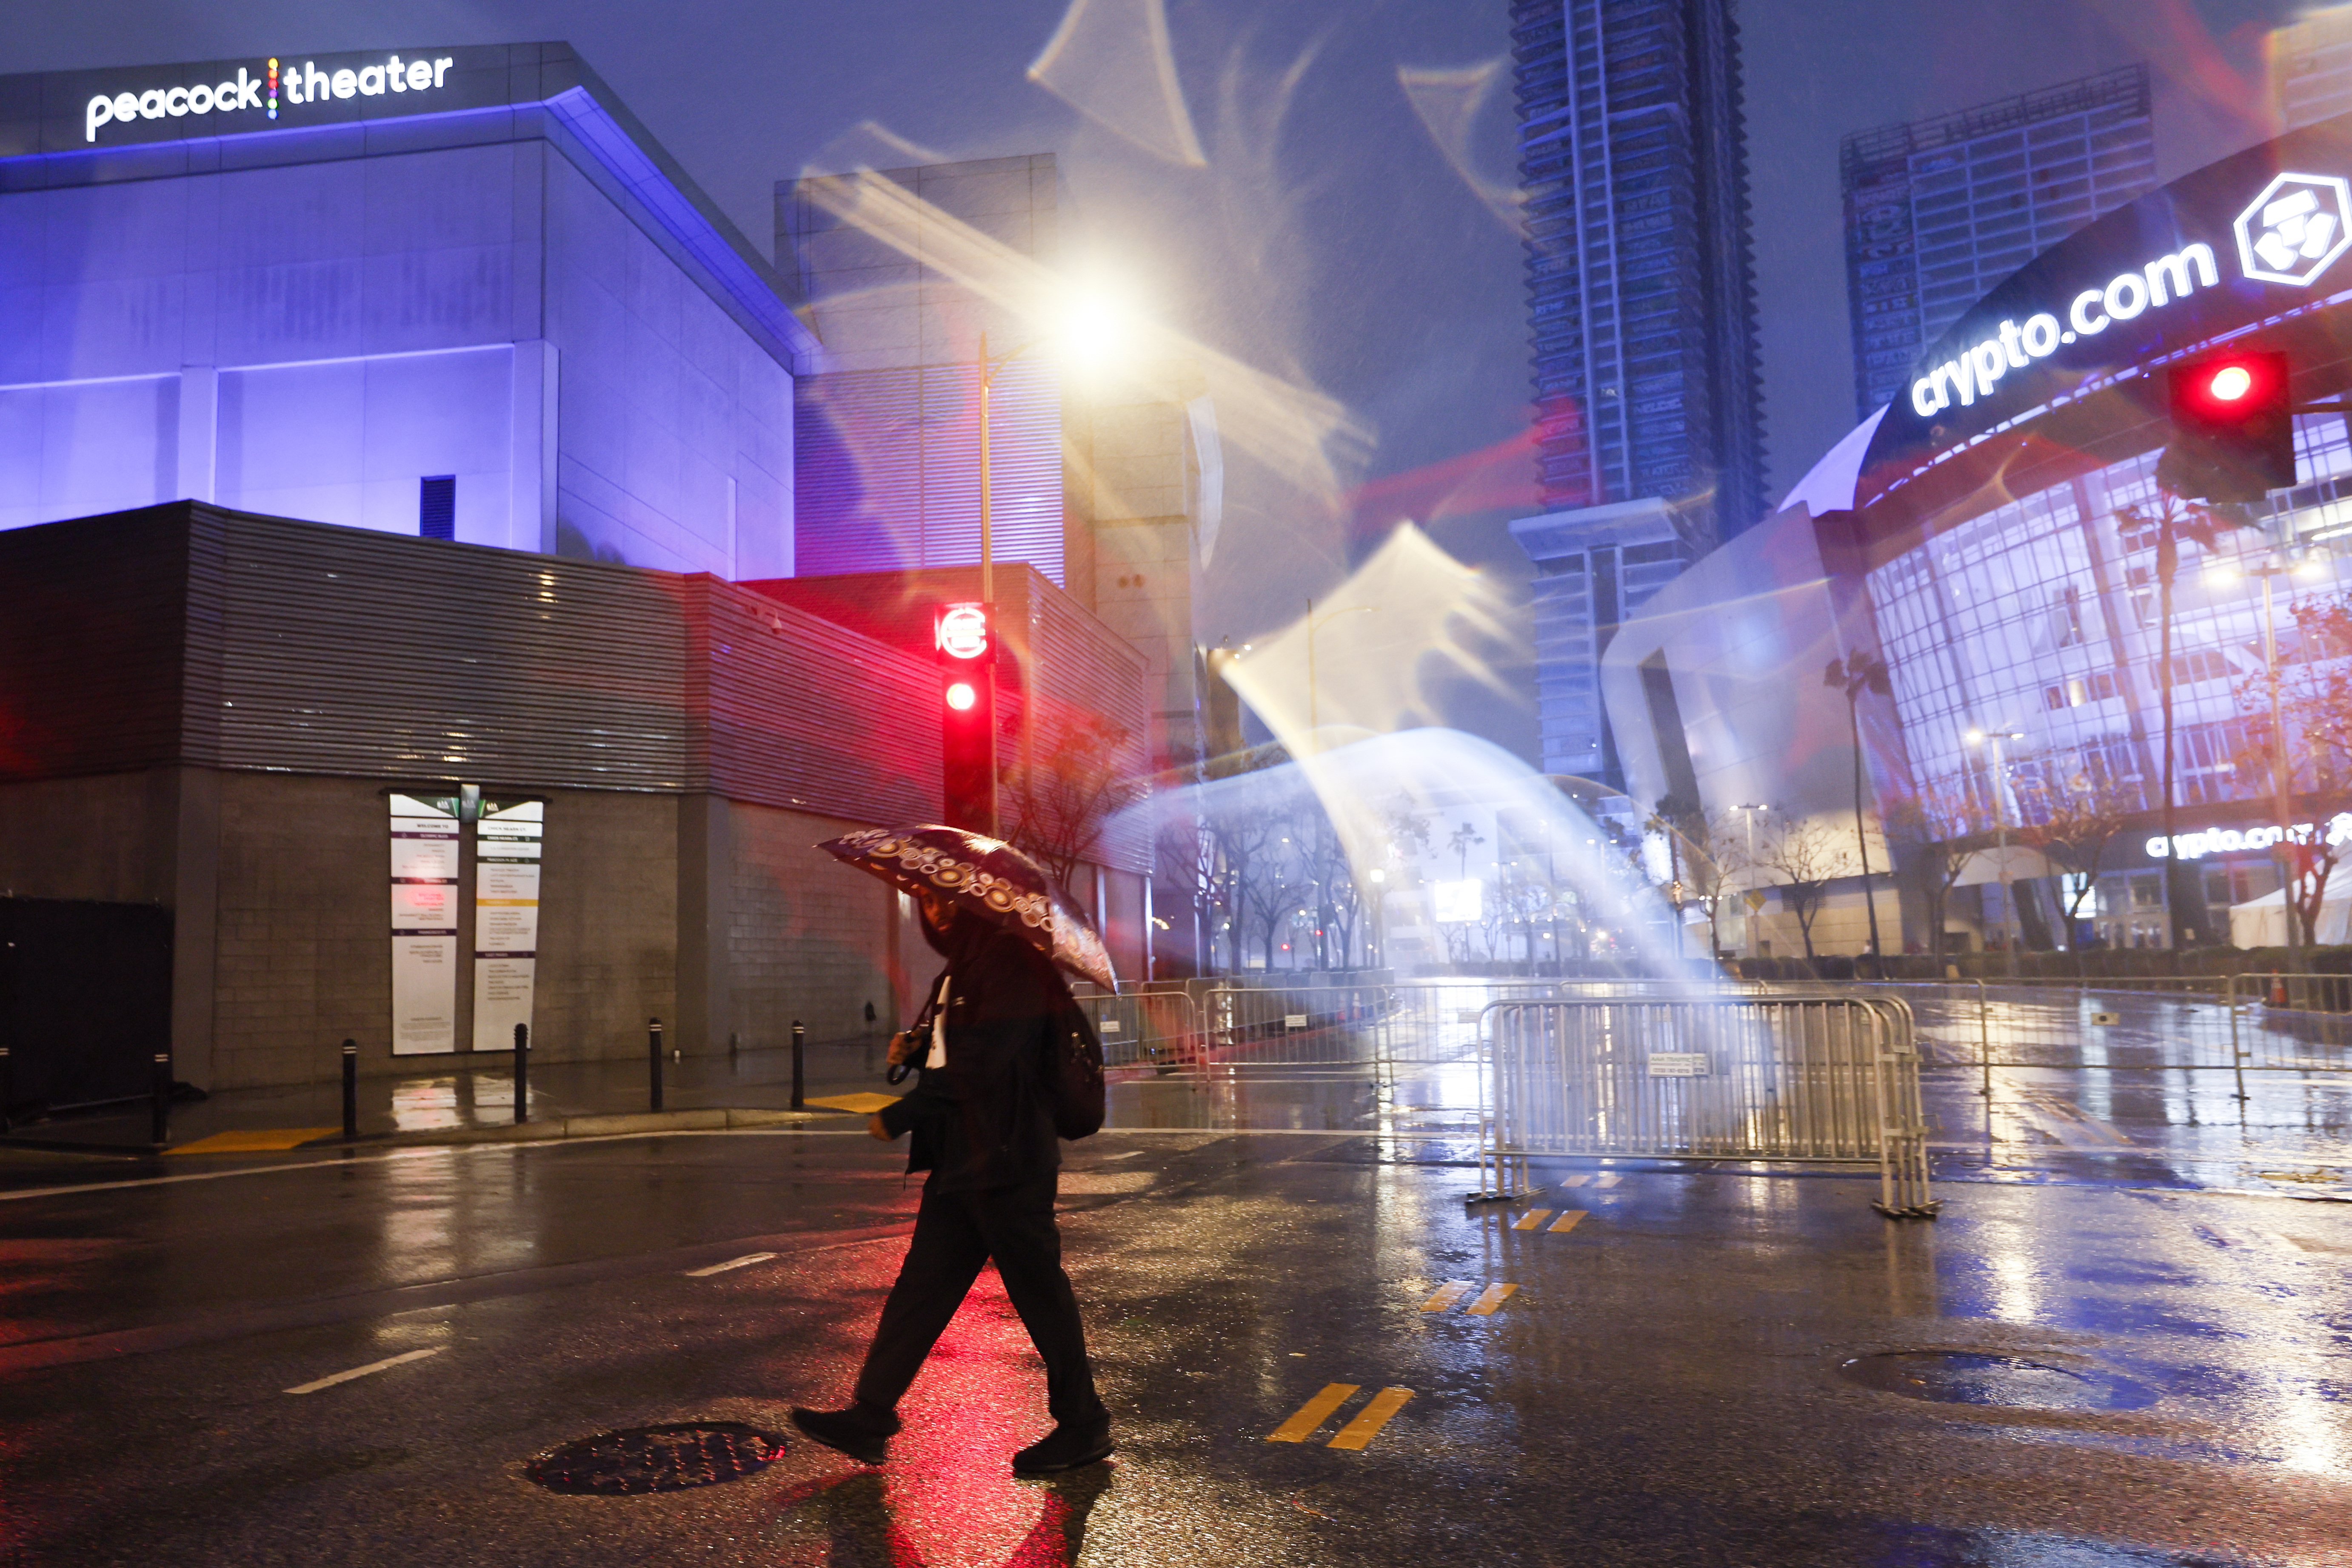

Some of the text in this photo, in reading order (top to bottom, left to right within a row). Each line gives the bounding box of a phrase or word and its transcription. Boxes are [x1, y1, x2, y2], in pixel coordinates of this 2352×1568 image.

[86, 56, 454, 142] peacock theater
[1912, 243, 2219, 417] crypto.com
